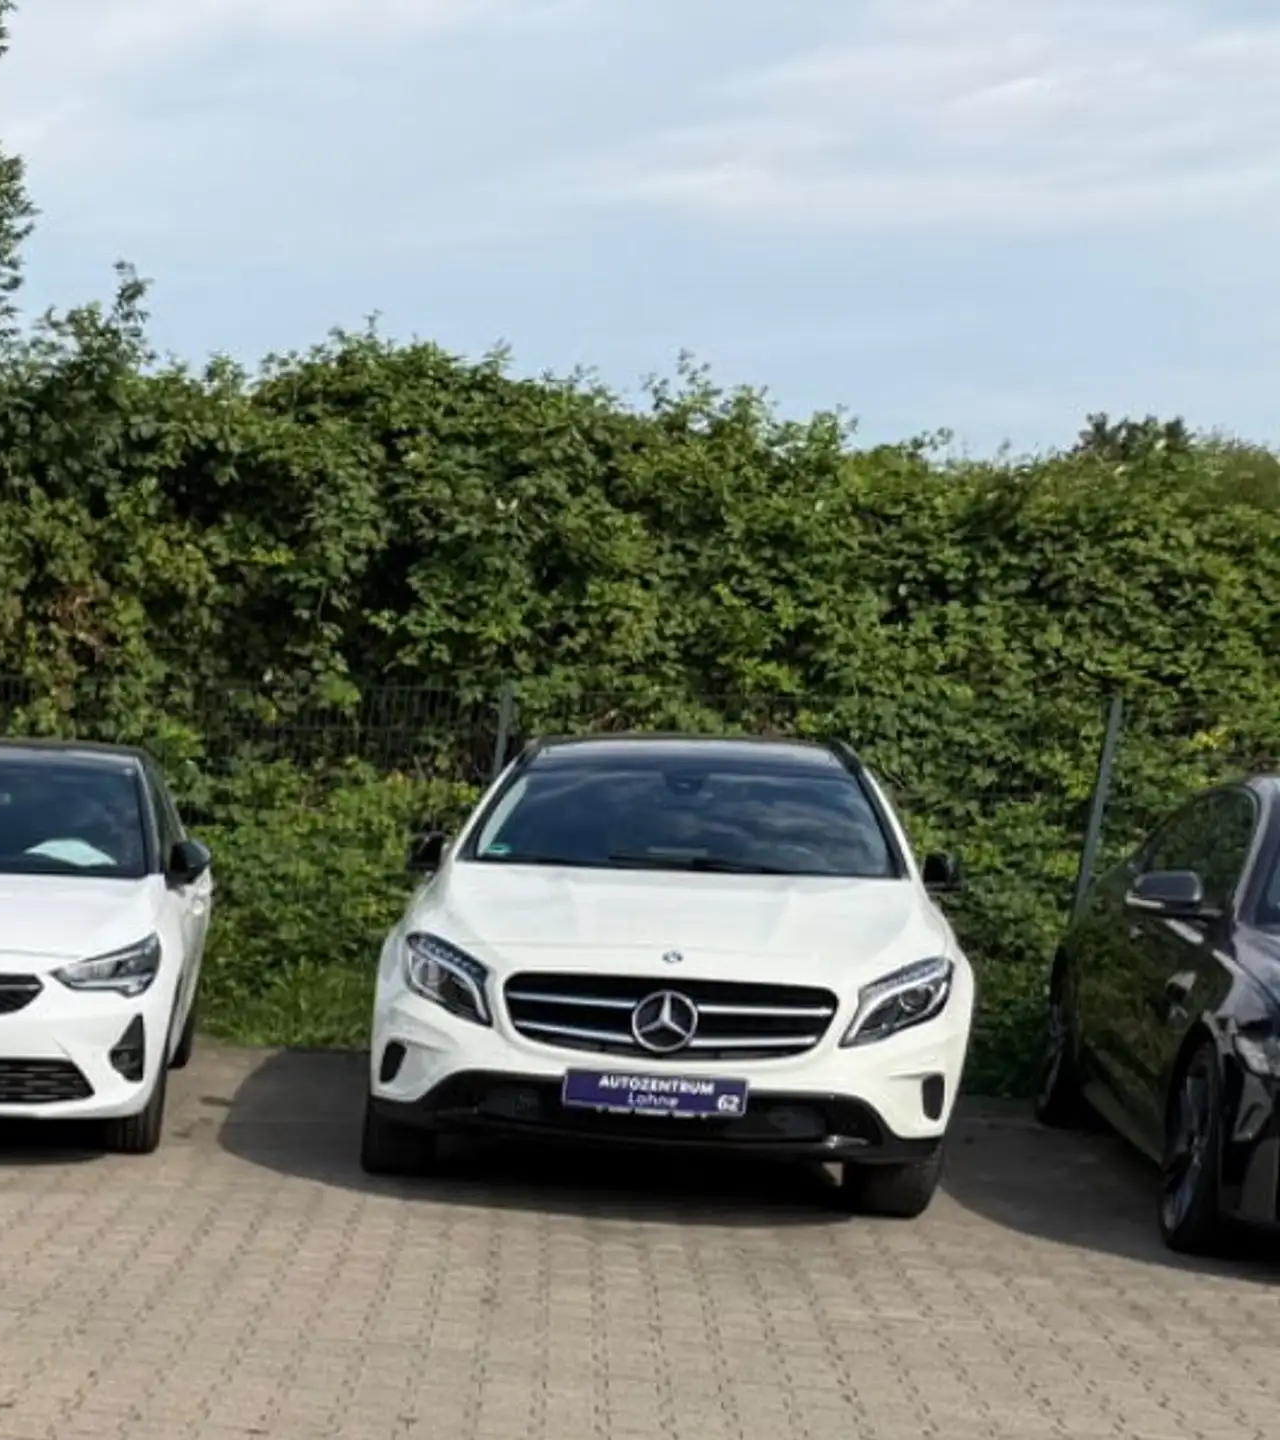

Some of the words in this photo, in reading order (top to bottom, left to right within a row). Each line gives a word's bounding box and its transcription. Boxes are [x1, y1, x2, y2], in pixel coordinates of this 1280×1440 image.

[598, 1075, 715, 1096] AUTOZENTRUM
[628, 1091, 680, 1109] Lohne
[716, 1094, 740, 1113] 62
